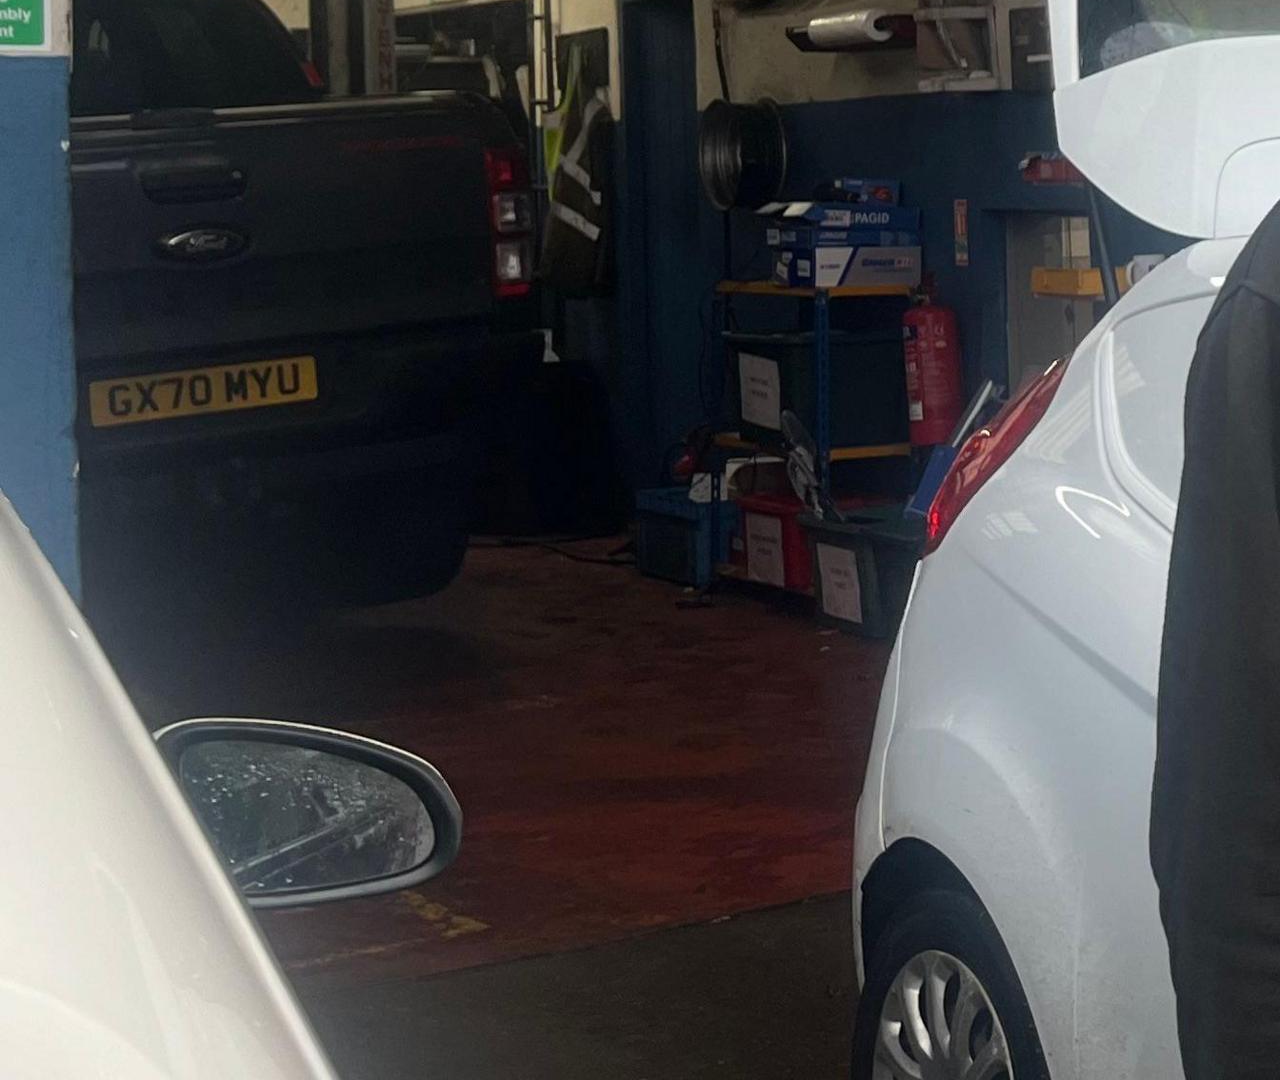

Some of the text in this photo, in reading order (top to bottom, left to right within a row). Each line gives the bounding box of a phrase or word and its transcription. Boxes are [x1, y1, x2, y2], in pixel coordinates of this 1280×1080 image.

[855, 212, 890, 224] PAGID
[108, 363, 300, 417] GX70 MYU
